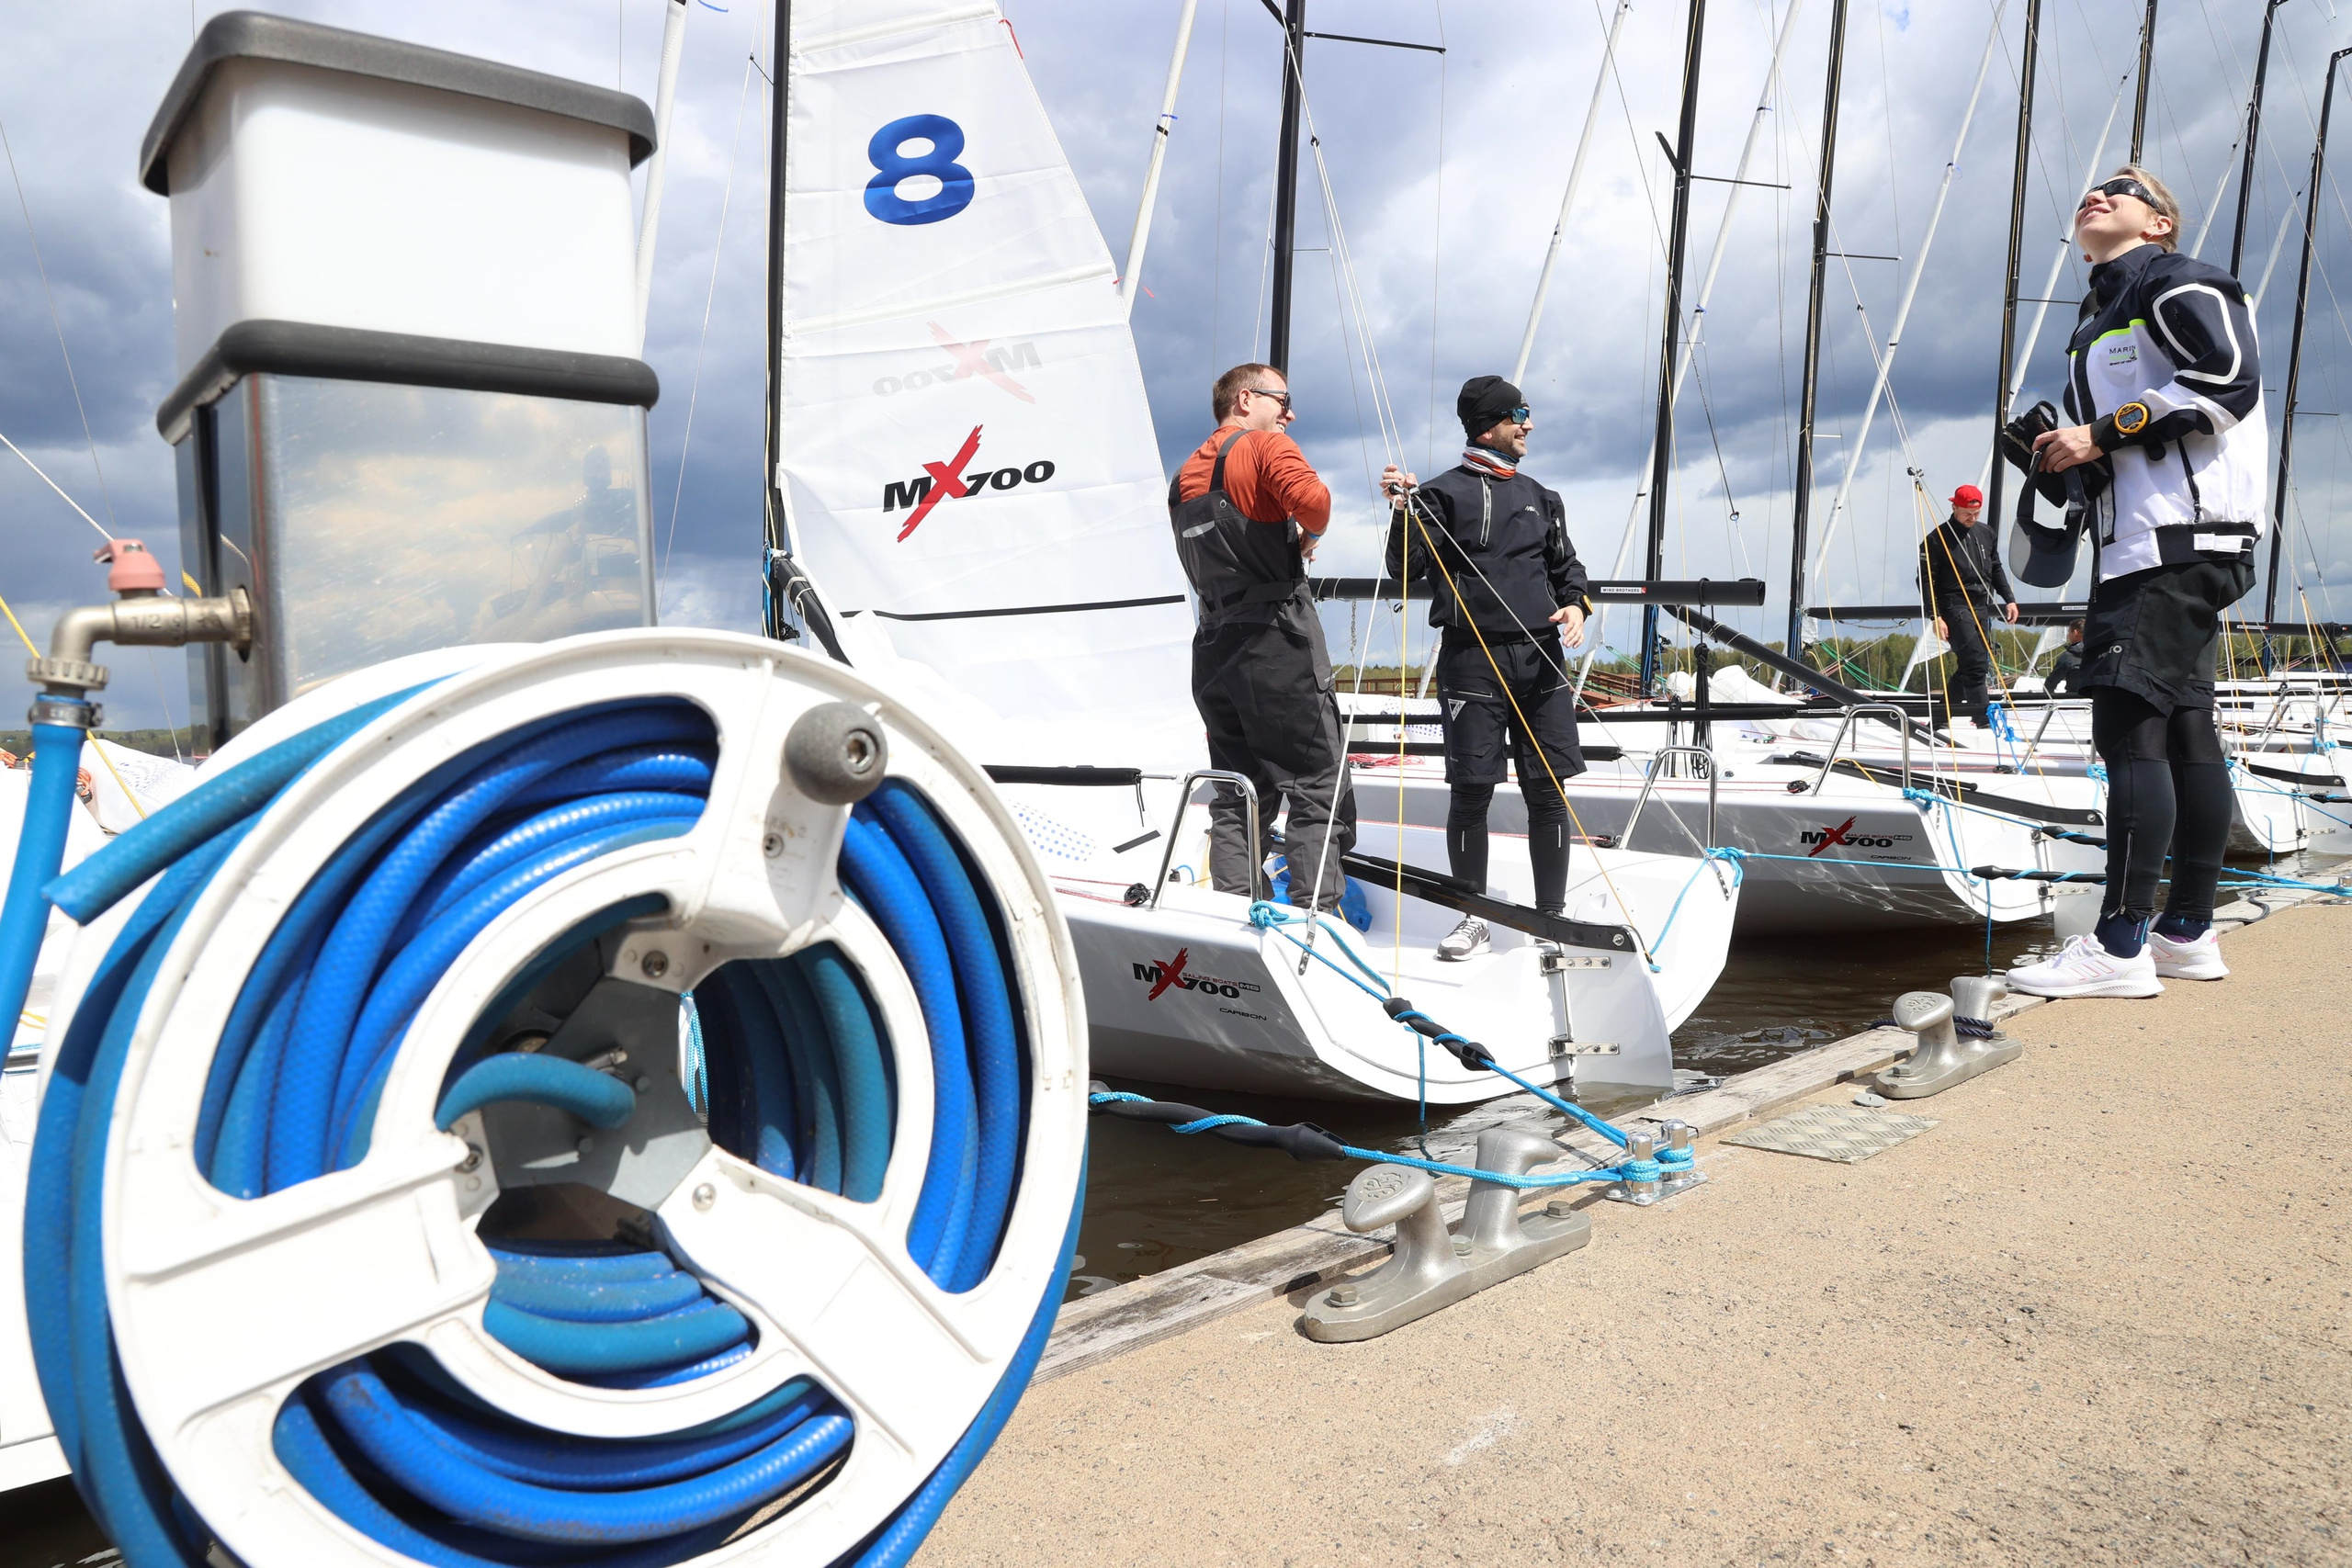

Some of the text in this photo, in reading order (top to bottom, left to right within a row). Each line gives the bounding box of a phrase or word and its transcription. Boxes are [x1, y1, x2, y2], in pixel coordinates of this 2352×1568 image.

[864, 114, 975, 225] 8
[883, 424, 1056, 543] MX700
[1800, 816, 1894, 858] MX700
[1132, 947, 1240, 1001] MX700
[1182, 972, 1261, 992] SAILING BOATS MG
[1219, 1007, 1267, 1021] CARBON
